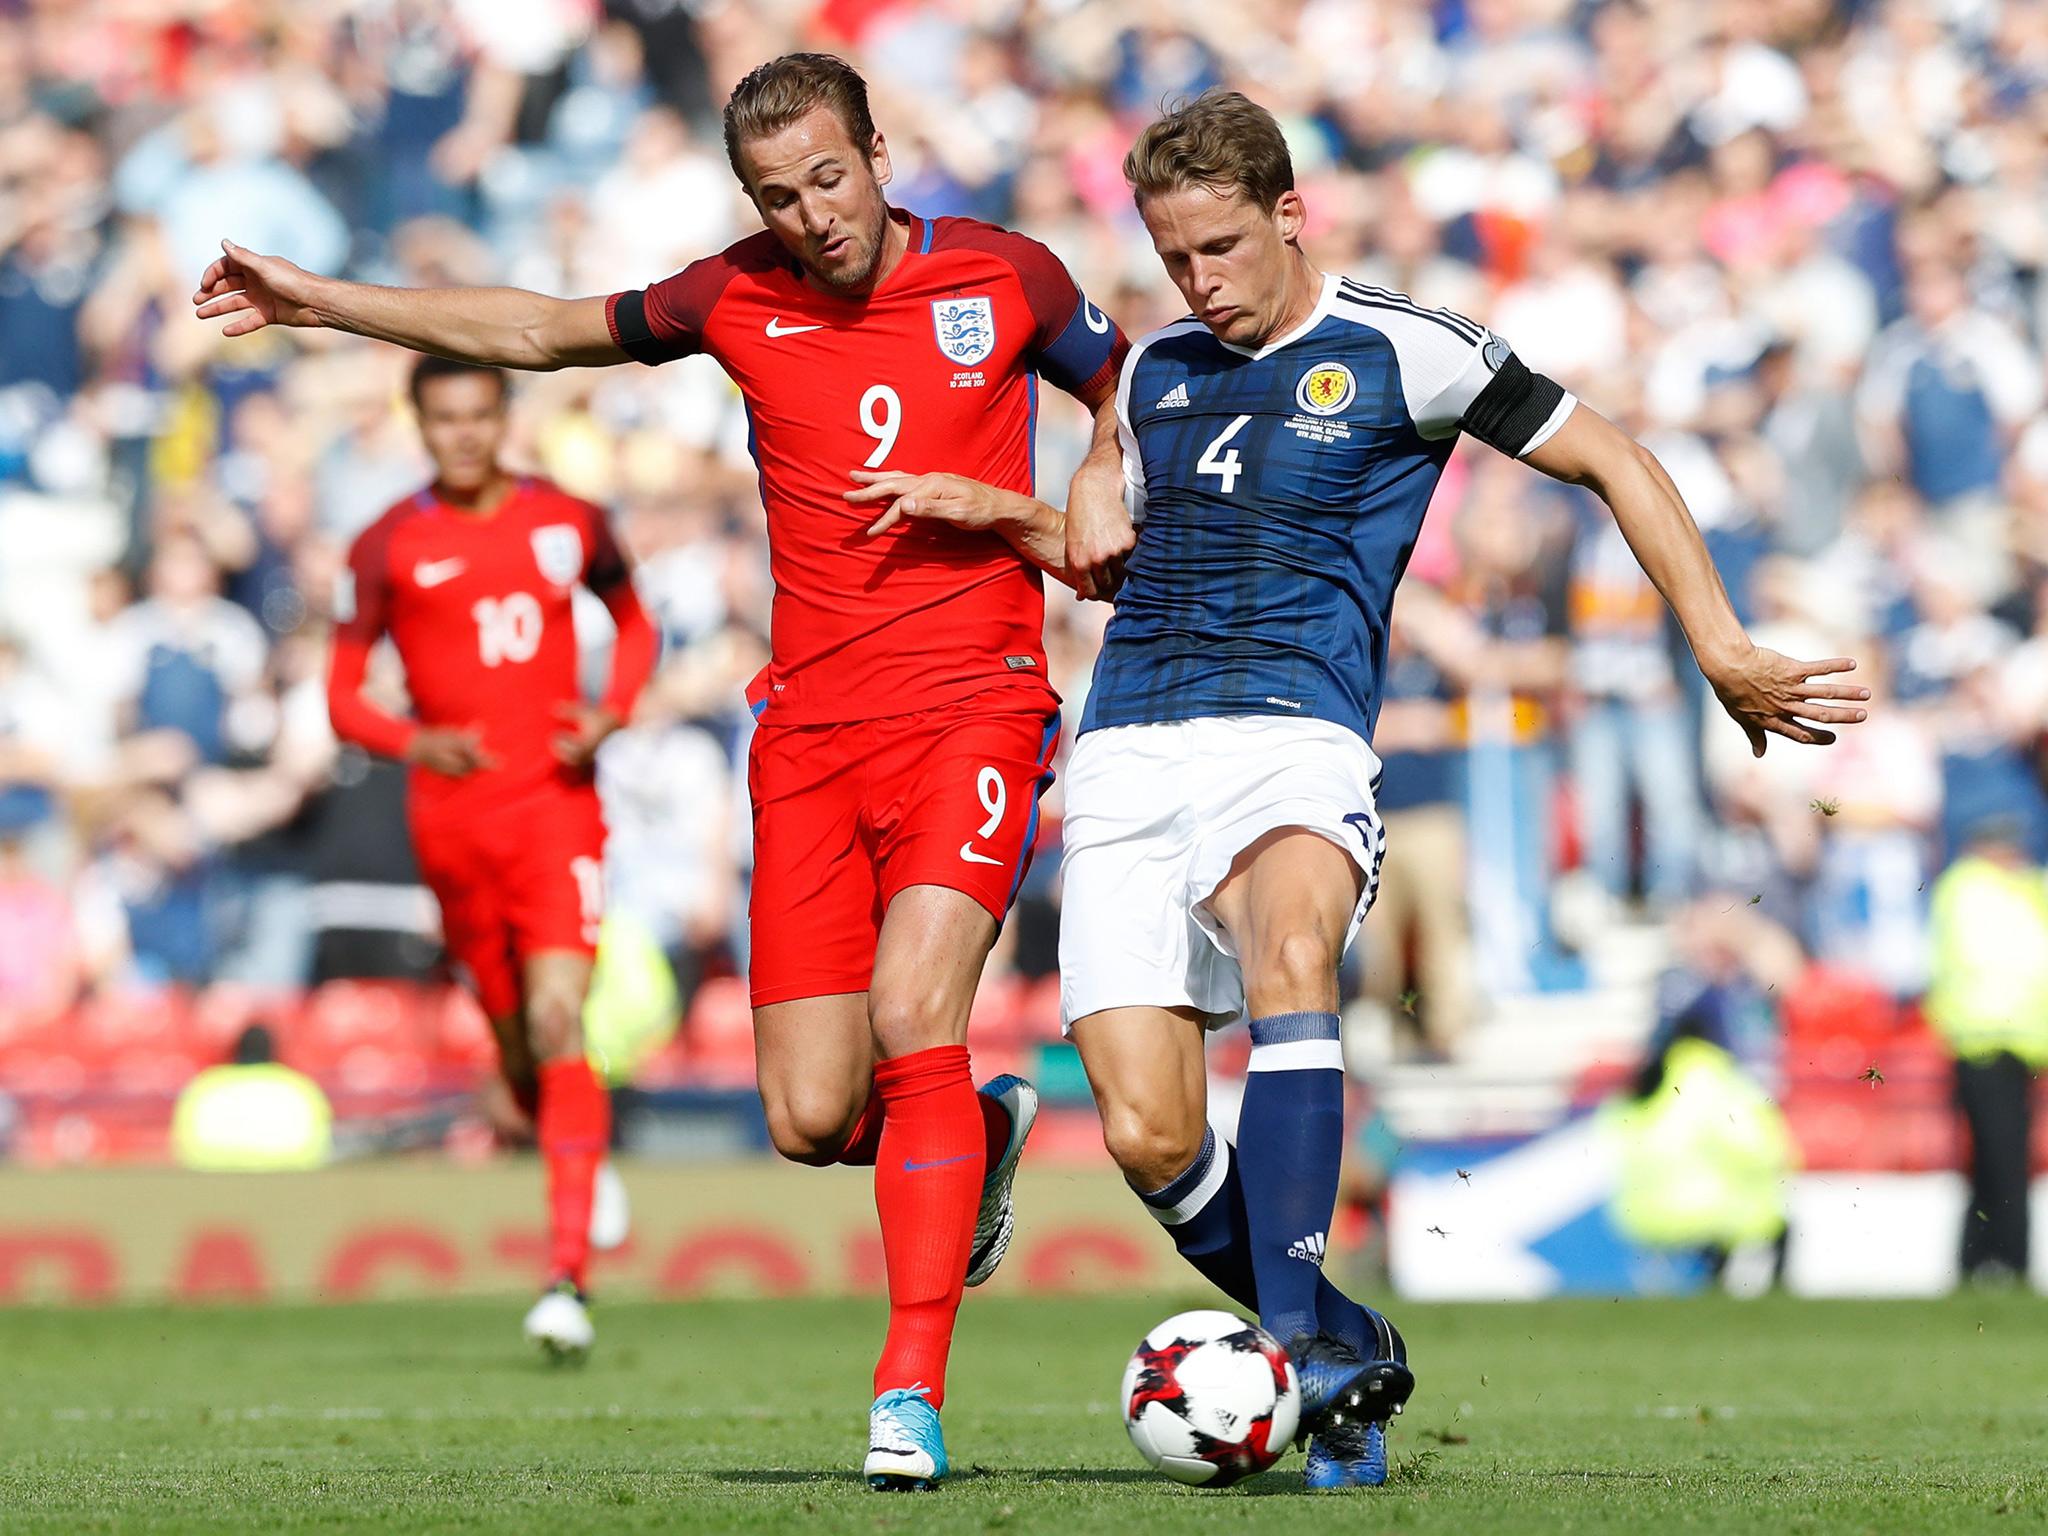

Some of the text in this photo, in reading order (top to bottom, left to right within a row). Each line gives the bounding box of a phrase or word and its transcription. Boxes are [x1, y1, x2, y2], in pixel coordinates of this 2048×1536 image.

[949, 378, 986, 388] 10 JUNE 2017
[953, 371, 984, 380] SCOTLAND
[859, 384, 902, 468] 9
[1325, 428, 1351, 439] GLASGOW
[1196, 414, 1252, 494] 4
[470, 591, 544, 668] 10
[1265, 696, 1301, 709] climacool
[977, 766, 1006, 839] 9
